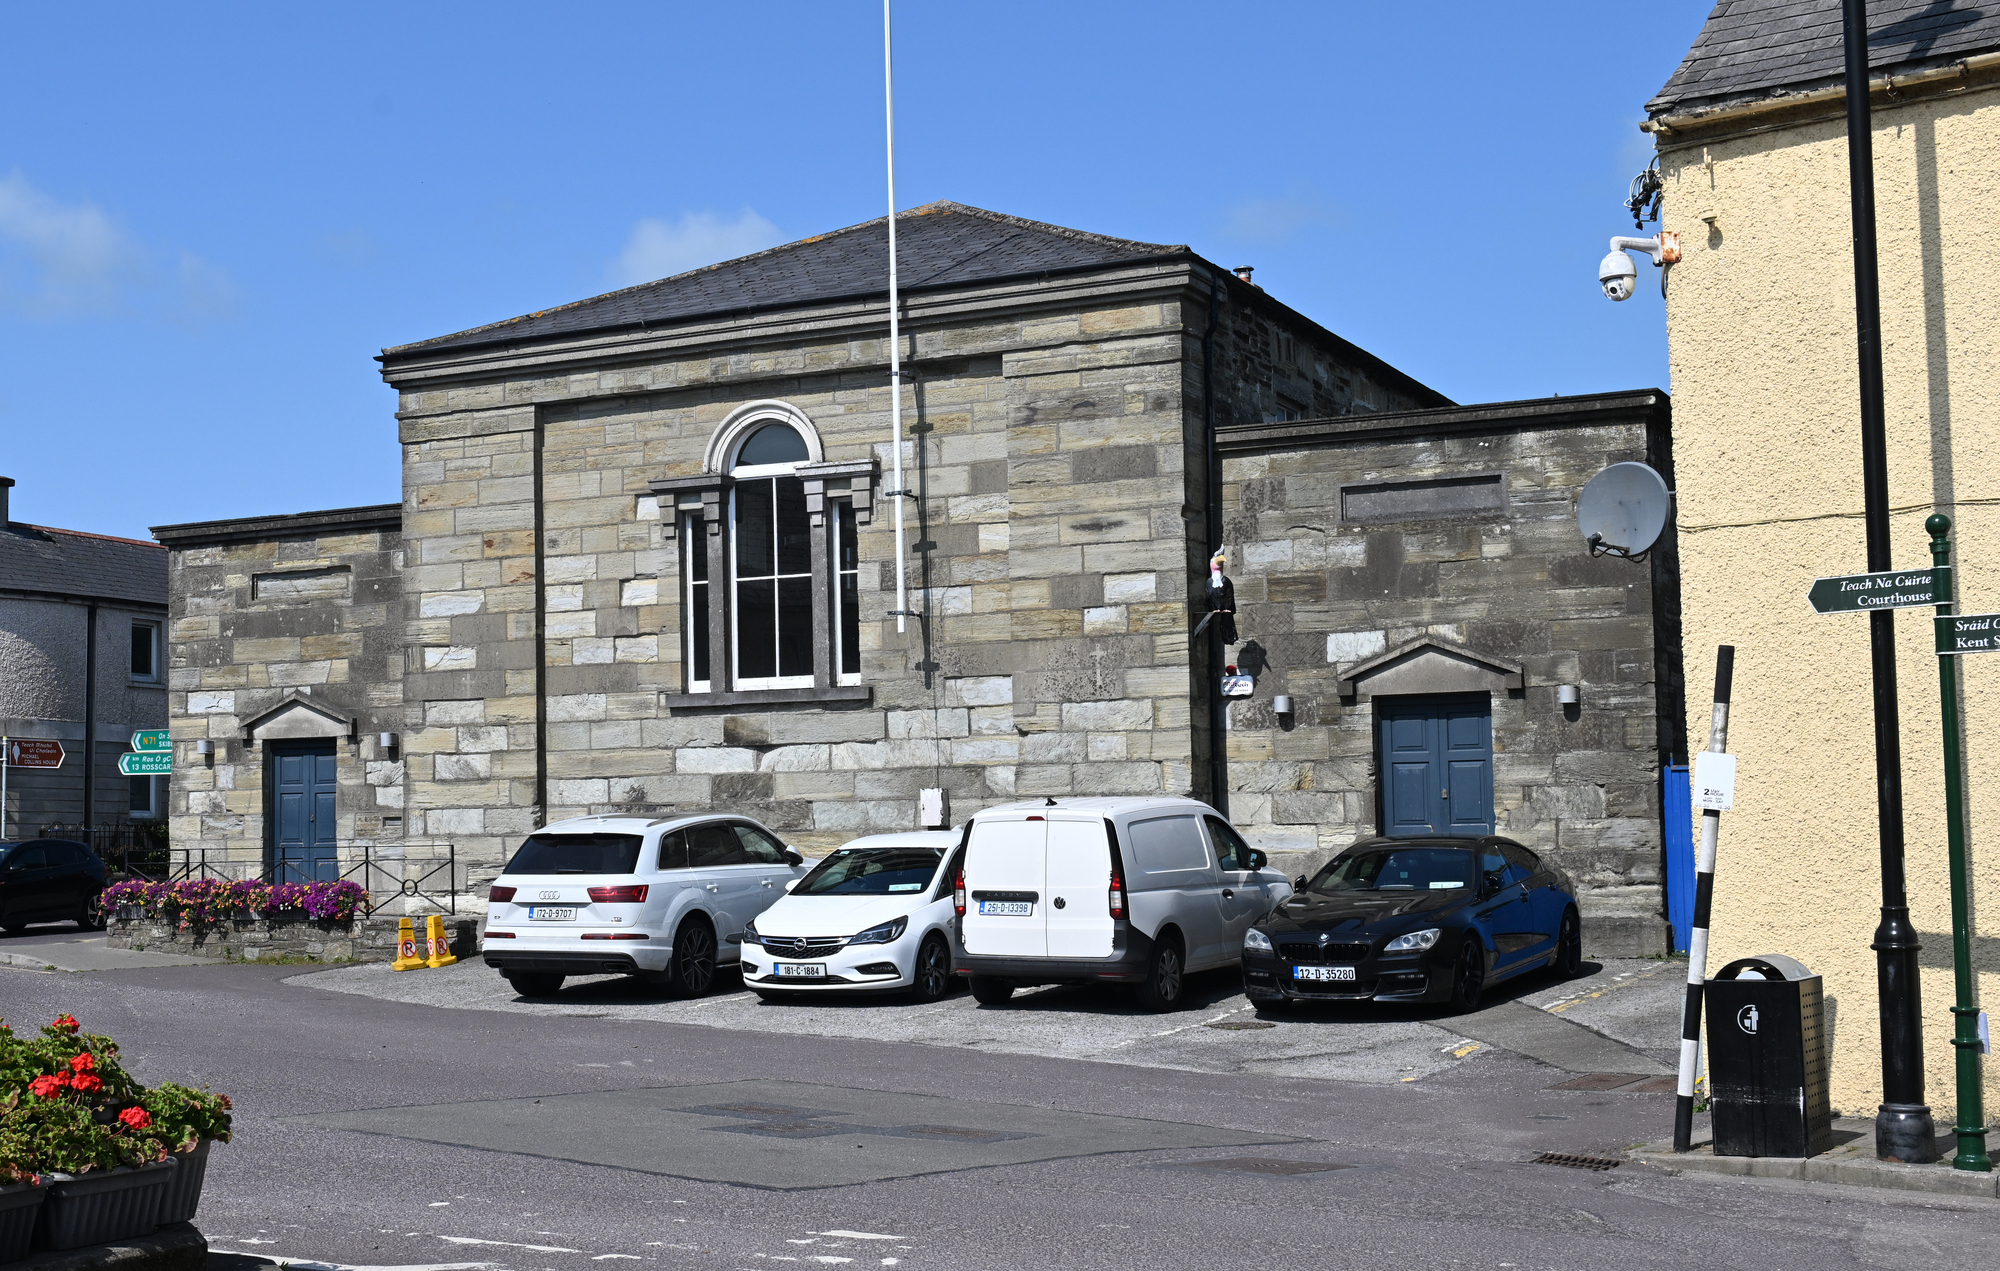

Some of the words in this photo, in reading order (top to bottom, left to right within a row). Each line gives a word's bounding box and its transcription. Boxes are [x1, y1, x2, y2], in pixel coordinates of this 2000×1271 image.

[1840, 579, 1872, 592] Teach
[1874, 577, 1892, 589] Na
[1895, 574, 1932, 586] Cúirte
[1857, 592, 1933, 606] Courthouse
[1954, 618, 1990, 632] Sráid
[1956, 637, 1989, 648] Kent
[143, 737, 157, 745] N71
[536, 908, 572, 918] 172-D-9707
[987, 903, 1028, 913] 251-D-13398
[784, 966, 819, 976] 181-C-1884
[1299, 968, 1354, 979] 12-D-35280
